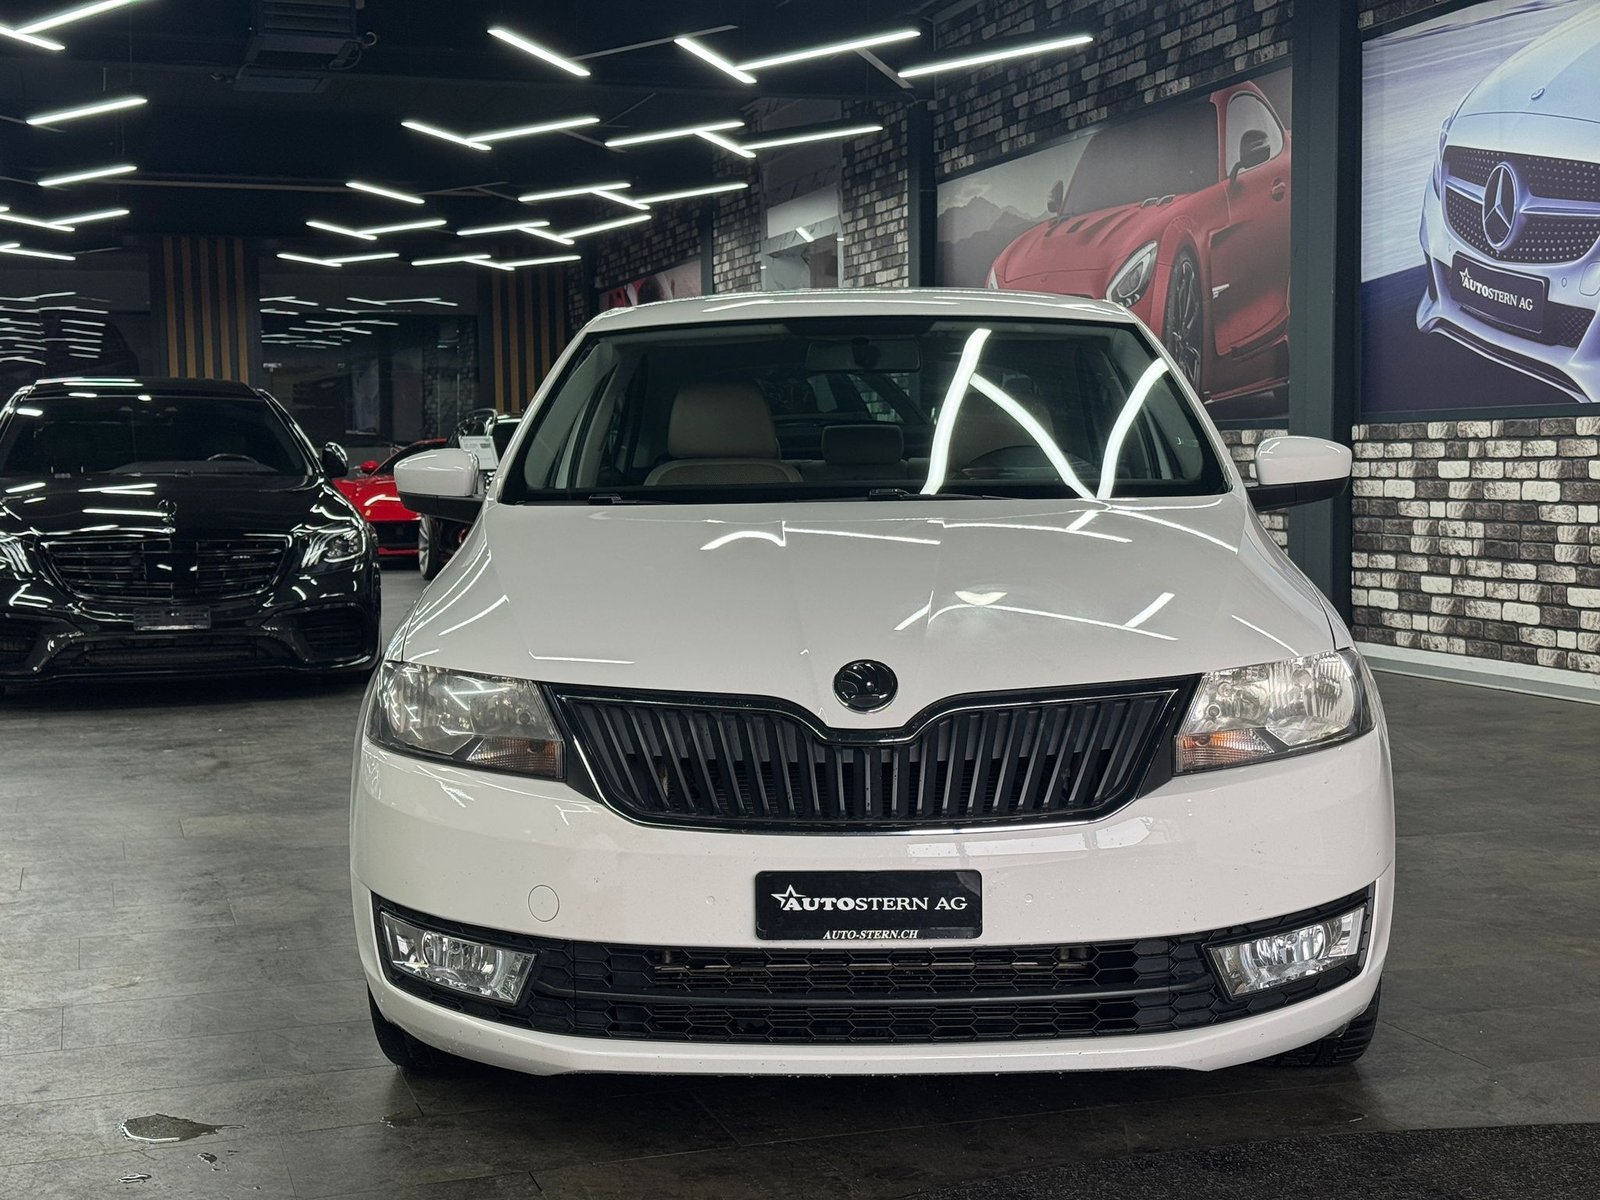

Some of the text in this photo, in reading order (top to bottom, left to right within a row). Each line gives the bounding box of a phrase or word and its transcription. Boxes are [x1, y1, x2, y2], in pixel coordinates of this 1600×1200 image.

[1462, 278, 1534, 311] AUTOSTERN AG
[782, 896, 968, 911] AUTOSTERN AG
[823, 929, 918, 940] AUTO-STERN.CH
